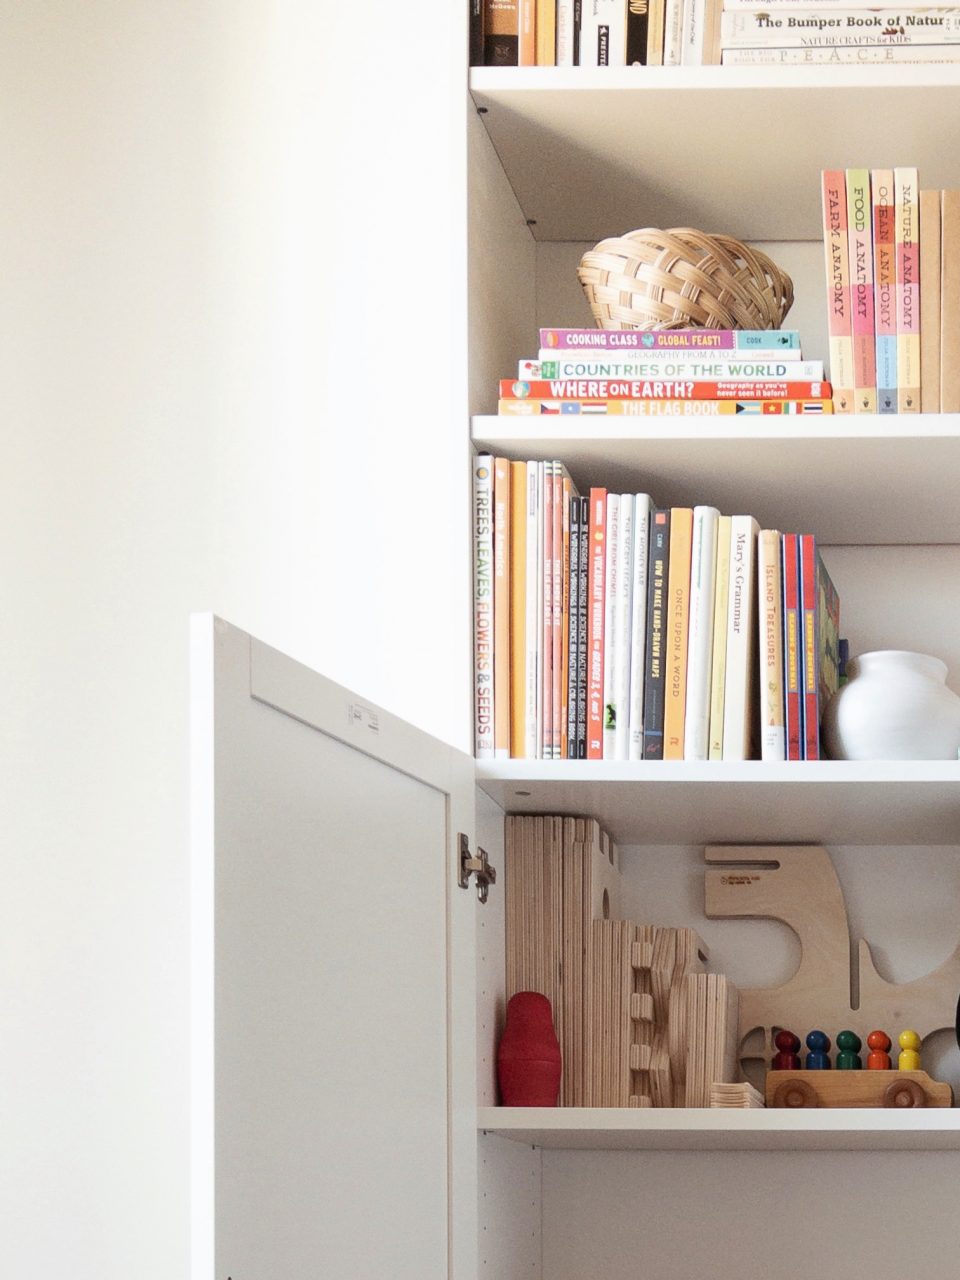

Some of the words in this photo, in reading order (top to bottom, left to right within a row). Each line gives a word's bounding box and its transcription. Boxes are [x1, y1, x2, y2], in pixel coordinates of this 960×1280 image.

[757, 16, 782, 28] The
[788, 16, 842, 30] Bumper
[846, 16, 883, 27] Book
[887, 15, 900, 26] of
[801, 36, 836, 46] NATURE
[839, 35, 876, 46] CRAFTS
[828, 189, 841, 237] FARM
[853, 187, 865, 232] FOOD
[878, 186, 889, 242] OCEAN
[902, 184, 912, 249] NATURE
[832, 244, 844, 317] ANATOMY
[856, 239, 867, 318] ANATOMY
[880, 249, 891, 327] ANATOMY
[903, 254, 913, 329] ANATOMY
[566, 334, 607, 345] COOKING
[609, 335, 638, 346] CLASS
[658, 335, 690, 346] GLOBAL
[692, 335, 721, 346] FEAST!
[628, 351, 680, 359] GEOGRAPHY
[683, 351, 707, 359] FROM
[708, 351, 716, 359] A
[718, 351, 728, 359] TO
[729, 350, 737, 358] Z
[550, 381, 608, 397] WHERE
[610, 383, 629, 396] ON
[631, 382, 695, 398] EARTH?
[564, 364, 660, 376] COUNTRIES
[664, 364, 686, 376] OF
[691, 364, 723, 376] THE
[728, 364, 787, 376] WORLD
[717, 382, 755, 390] Geography
[623, 401, 649, 415] THE
[650, 402, 683, 415] FLAG
[684, 402, 720, 415] BOOK
[475, 489, 490, 541] TREES,
[476, 541, 490, 600] LEAVES,
[496, 533, 505, 577] America
[653, 560, 664, 576] HOW
[735, 532, 746, 572] Mary's
[593, 555, 602, 599] VOCABULARY
[653, 578, 663, 587] TO
[766, 564, 775, 603] ISLAND
[653, 589, 663, 608] MAKE
[675, 588, 683, 617] ONCE
[733, 575, 746, 634] Grammar
[477, 601, 490, 671] FLOWERS
[592, 602, 602, 640] WORKBOOK
[652, 610, 663, 656] HAND-DRAWN
[674, 621, 683, 651] UPON
[767, 606, 776, 667] TREASURES
[477, 673, 490, 684] &
[591, 650, 601, 681] GRADES
[651, 658, 660, 678] MAPS
[672, 665, 681, 697] WORD
[788, 648, 796, 689] JOURNAL
[806, 648, 814, 689] JOURNAL
[477, 686, 490, 735] SEEDS
